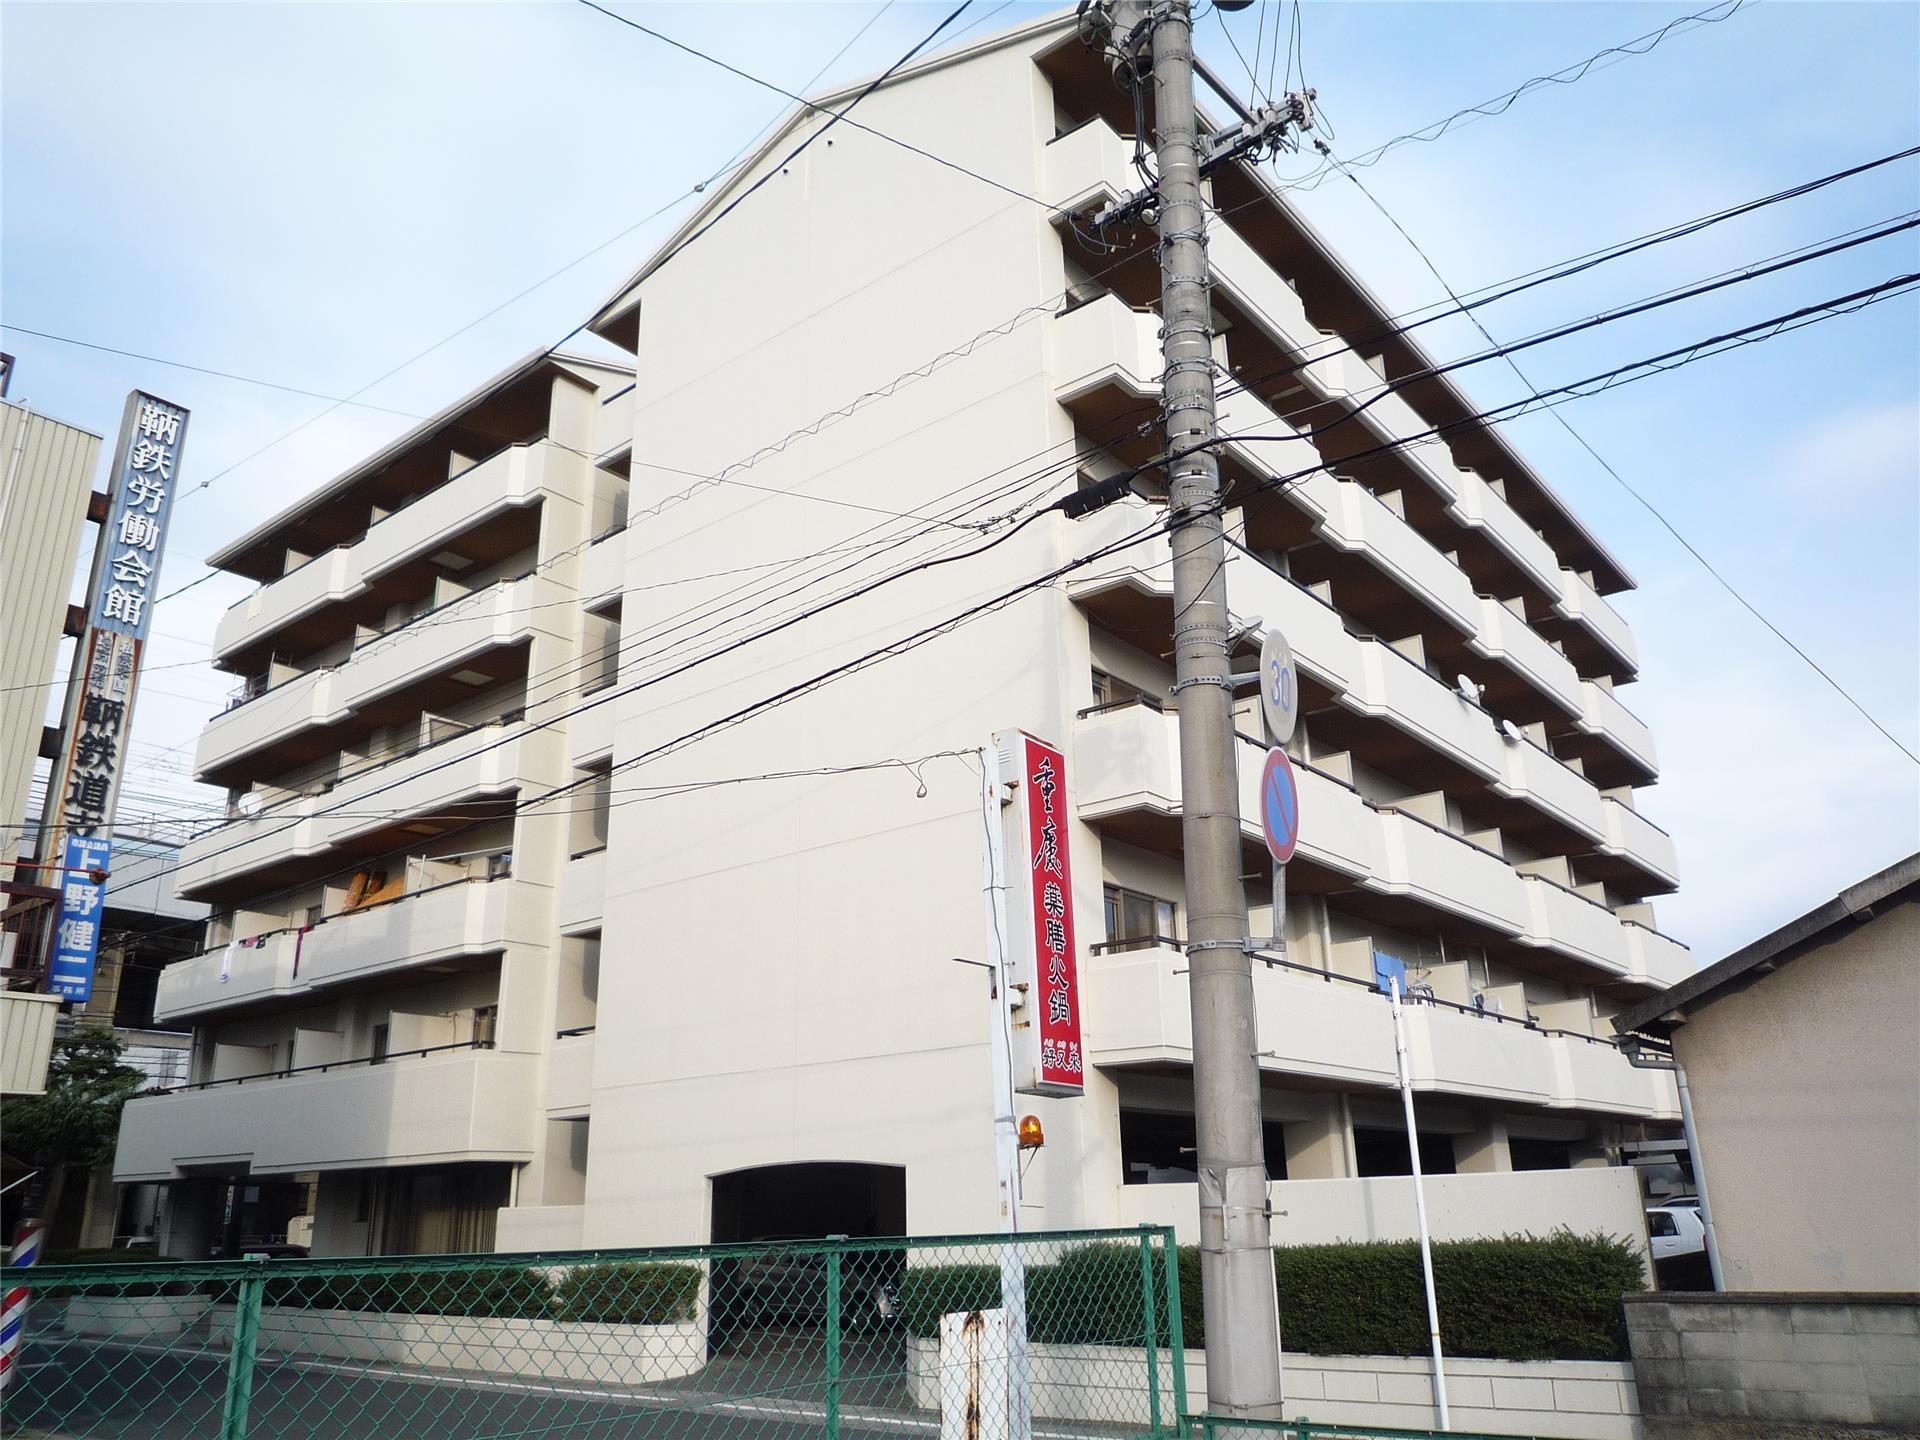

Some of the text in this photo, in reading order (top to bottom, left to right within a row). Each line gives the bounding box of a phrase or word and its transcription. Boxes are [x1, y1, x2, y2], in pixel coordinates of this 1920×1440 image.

[102, 403, 180, 626] 鞆鉄労働会館
[1271, 659, 1291, 712] 30
